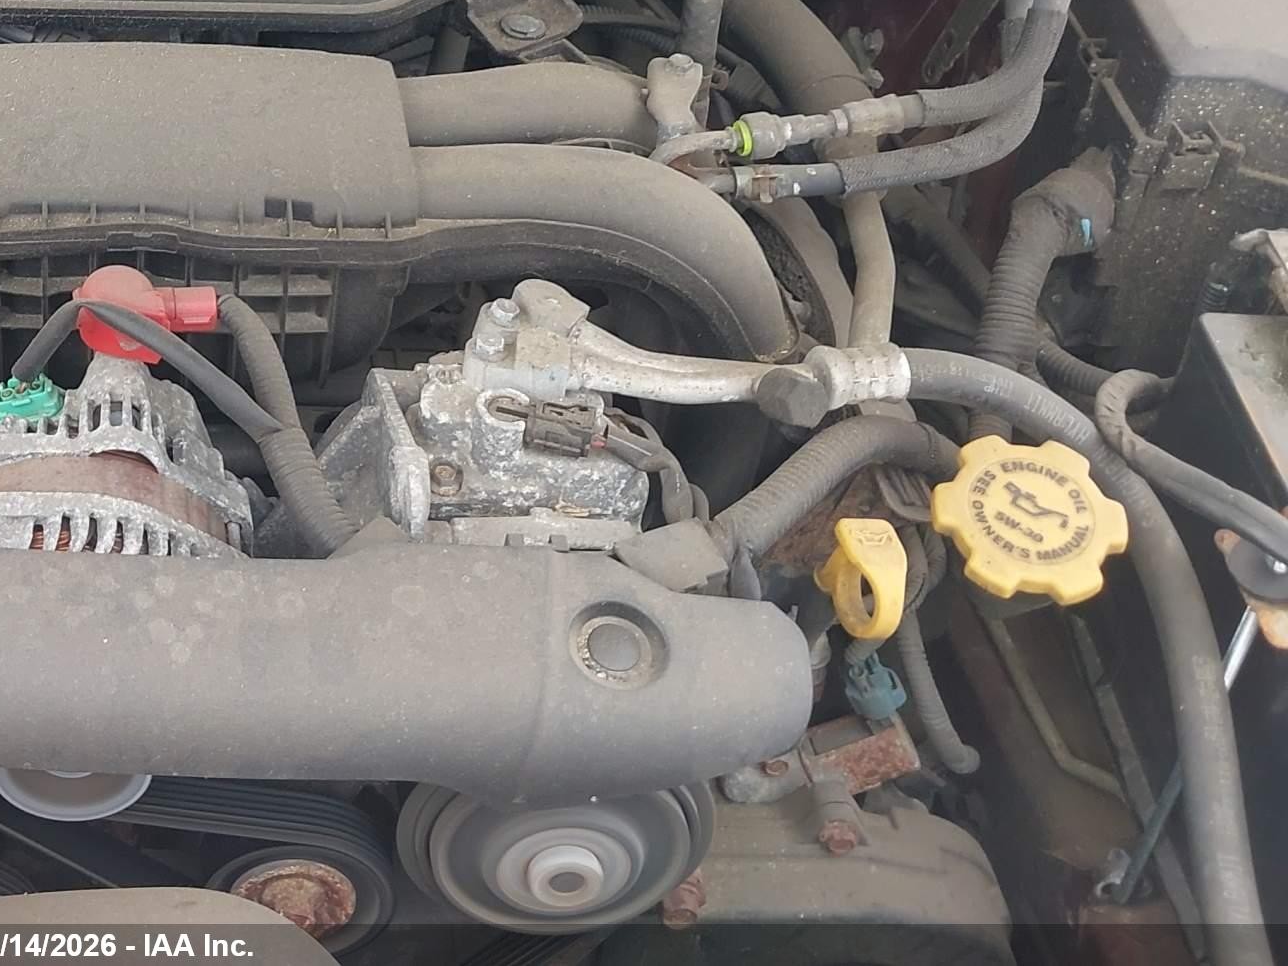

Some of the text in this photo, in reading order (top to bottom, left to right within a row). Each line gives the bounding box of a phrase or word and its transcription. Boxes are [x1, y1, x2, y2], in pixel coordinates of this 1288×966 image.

[1000, 461, 1069, 487] ENGINE
[1068, 489, 1087, 514] OIL
[972, 470, 1089, 560] SEE OWNER'S MANUAL
[994, 511, 1044, 543] 5W-30
